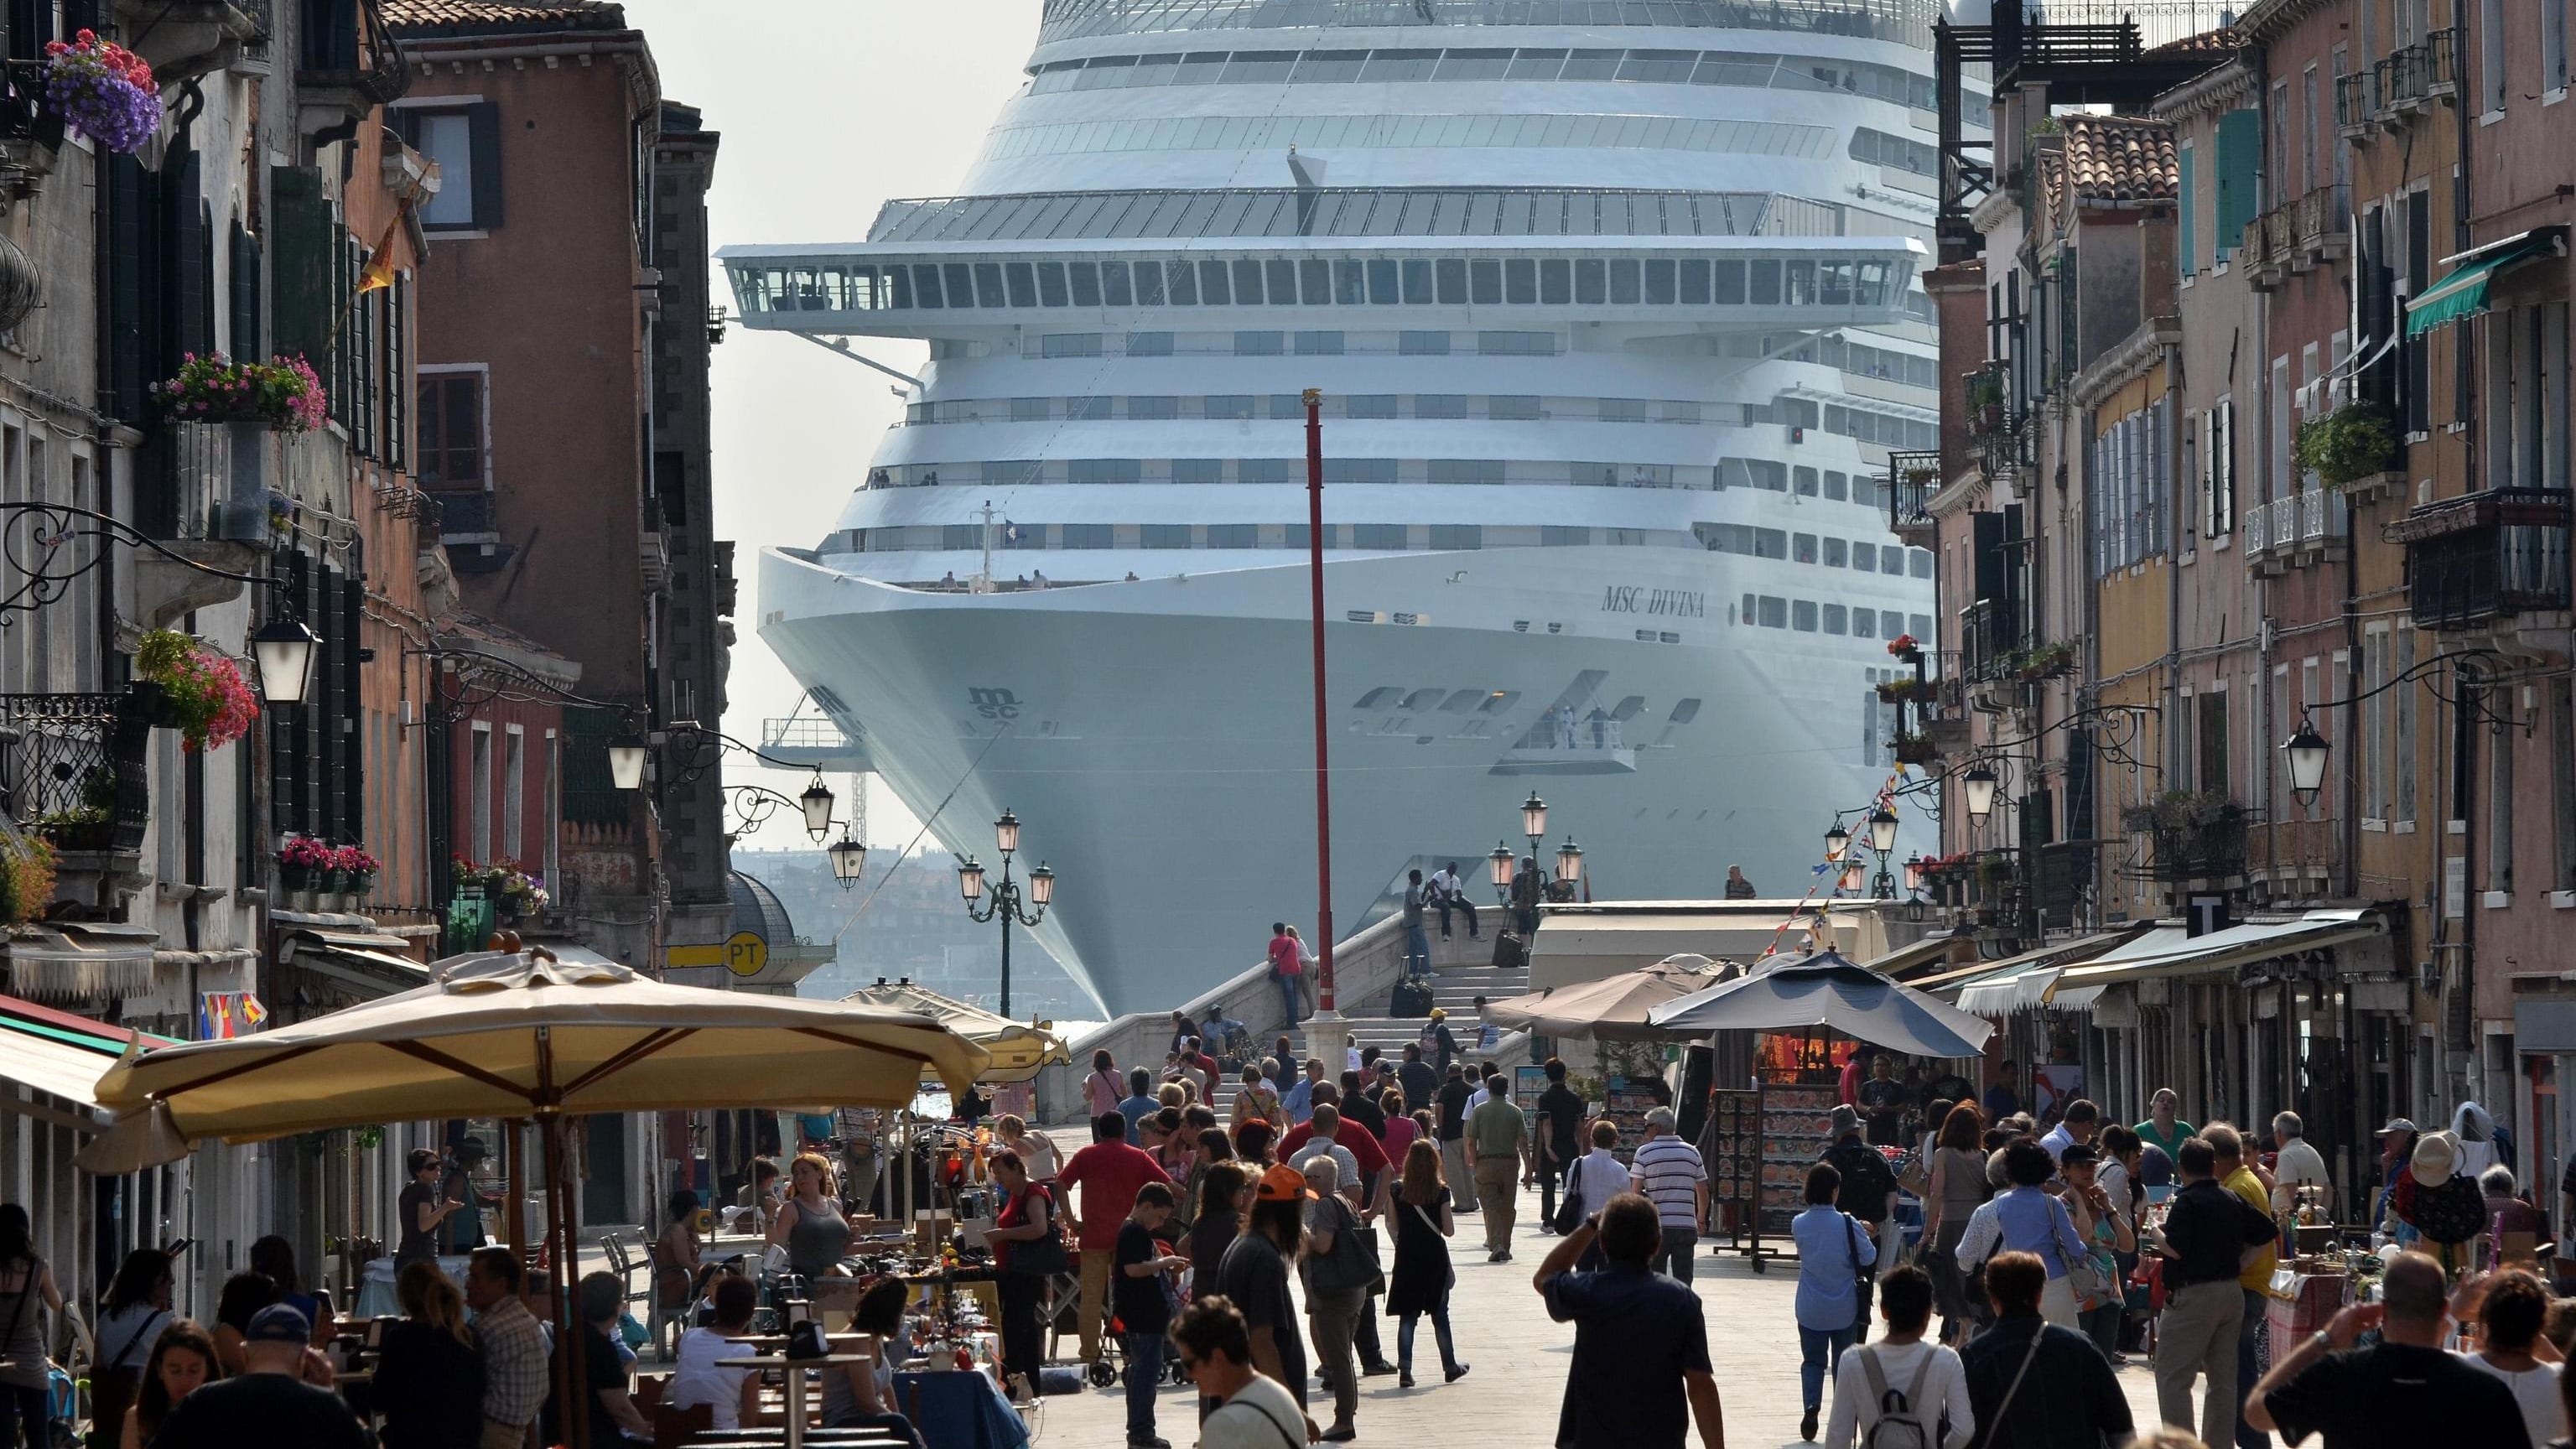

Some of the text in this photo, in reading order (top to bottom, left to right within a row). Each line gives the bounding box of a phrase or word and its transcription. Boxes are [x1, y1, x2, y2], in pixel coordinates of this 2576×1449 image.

[1601, 585, 1705, 618] MSC DIVINA
[2192, 896, 2223, 936] T
[730, 943, 757, 965] PT
